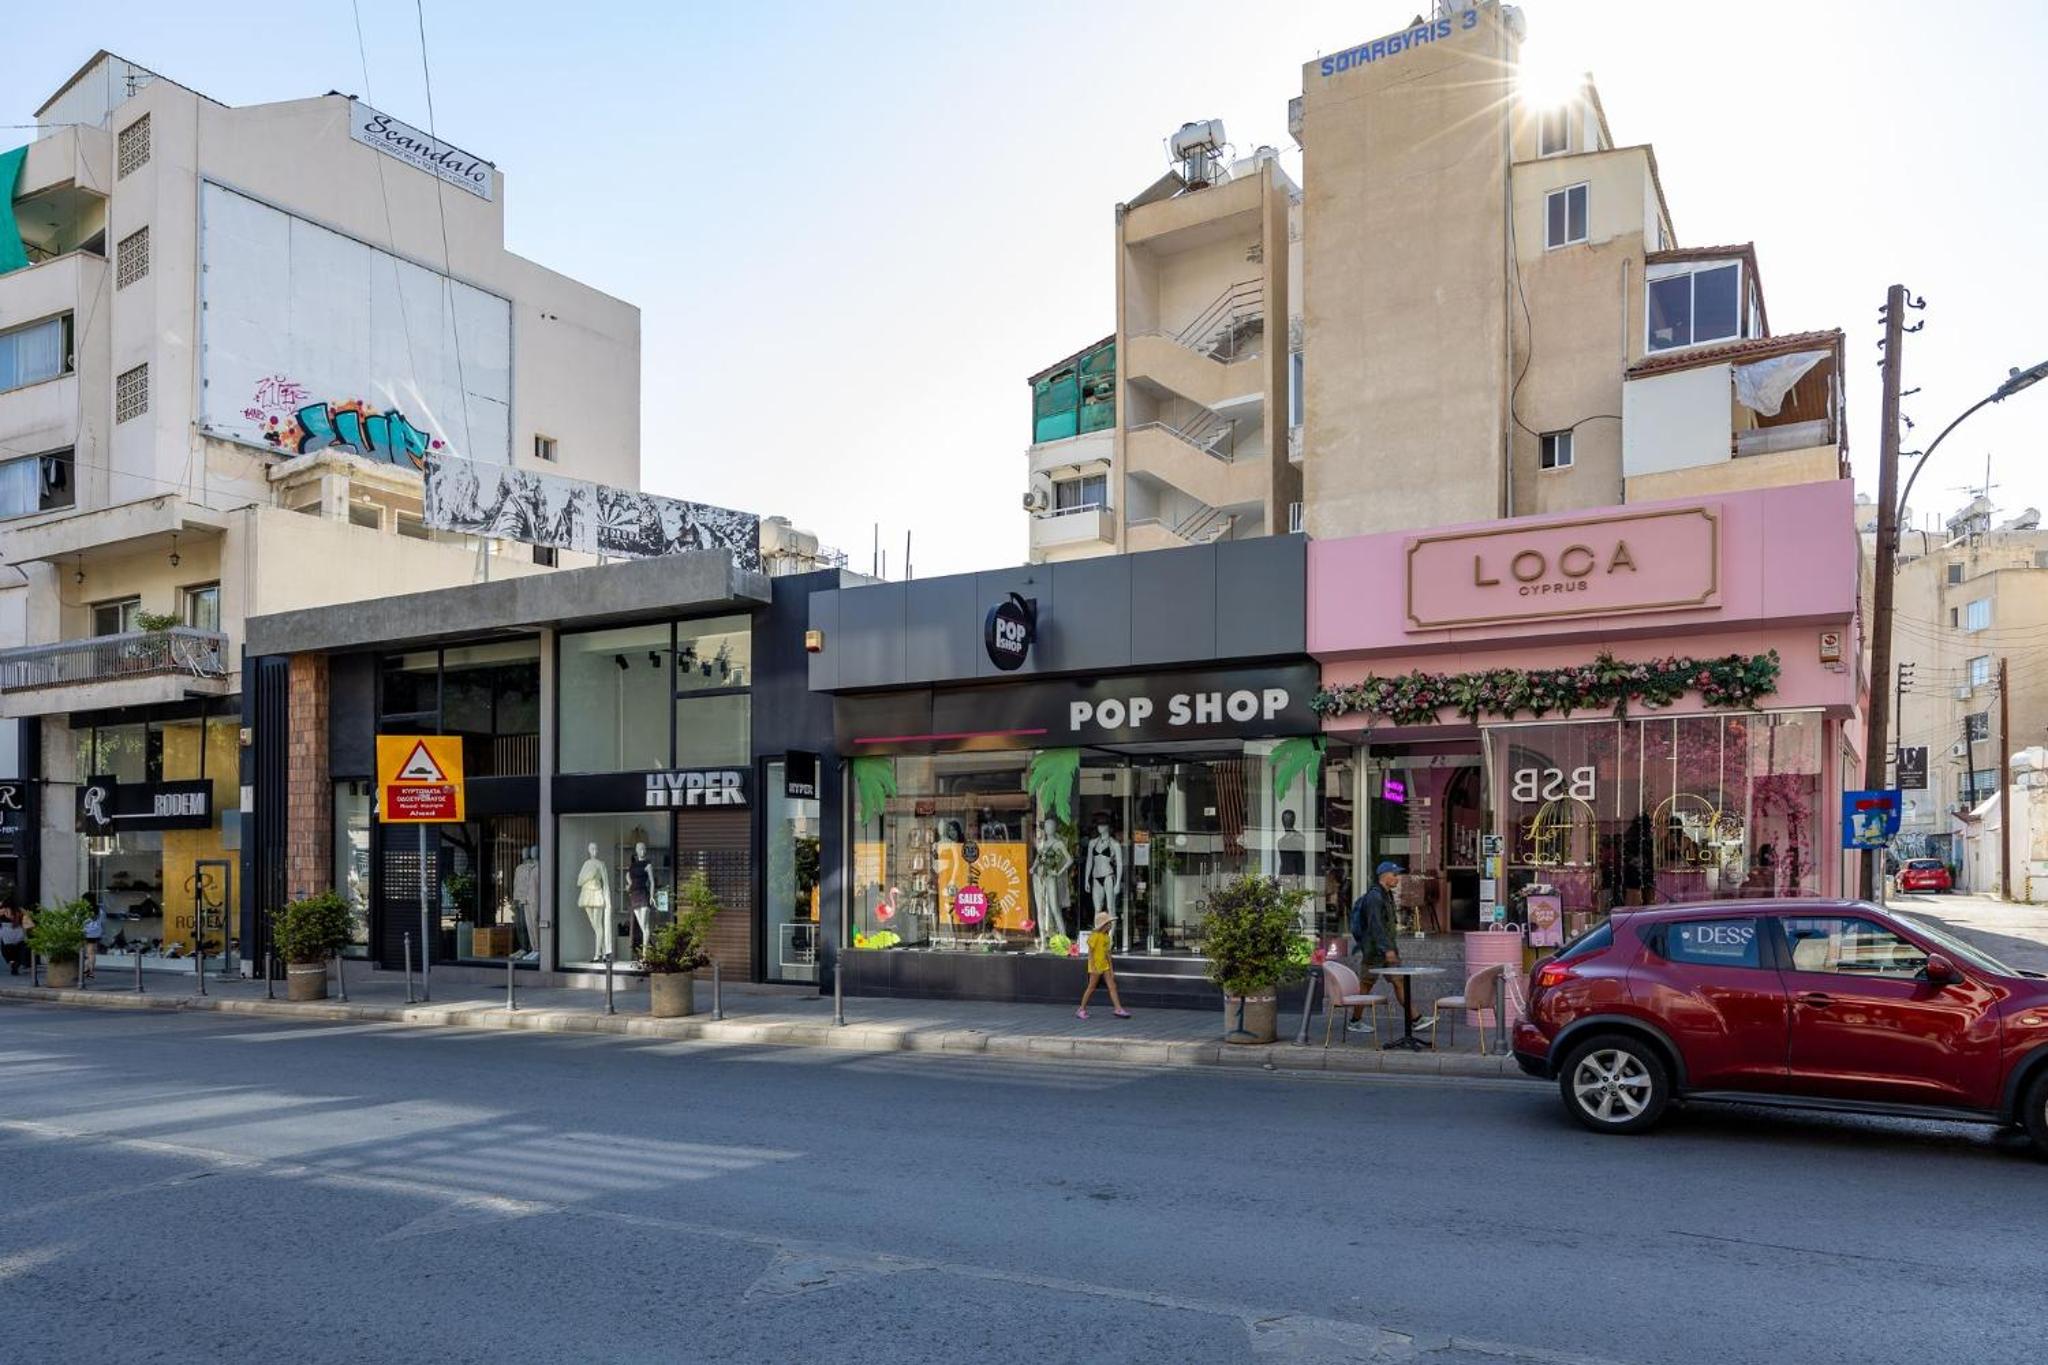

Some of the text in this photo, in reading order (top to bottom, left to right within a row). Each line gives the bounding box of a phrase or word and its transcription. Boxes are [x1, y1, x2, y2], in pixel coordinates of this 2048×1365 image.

[1321, 10, 1478, 77] SOTARGYRIS 3
[364, 115, 486, 182] Scandalo
[1474, 540, 1637, 587] LOCA
[1518, 580, 1588, 596] CYPRUS
[996, 617, 1026, 648] POP
[1000, 638, 1022, 652] SHOP
[1070, 688, 1289, 731] POP SHOP
[645, 771, 747, 807] HYPER
[788, 782, 813, 796] HYPER
[154, 792, 205, 817] RODEM
[958, 893, 983, 905] SALES
[1697, 926, 1754, 945] DESS
